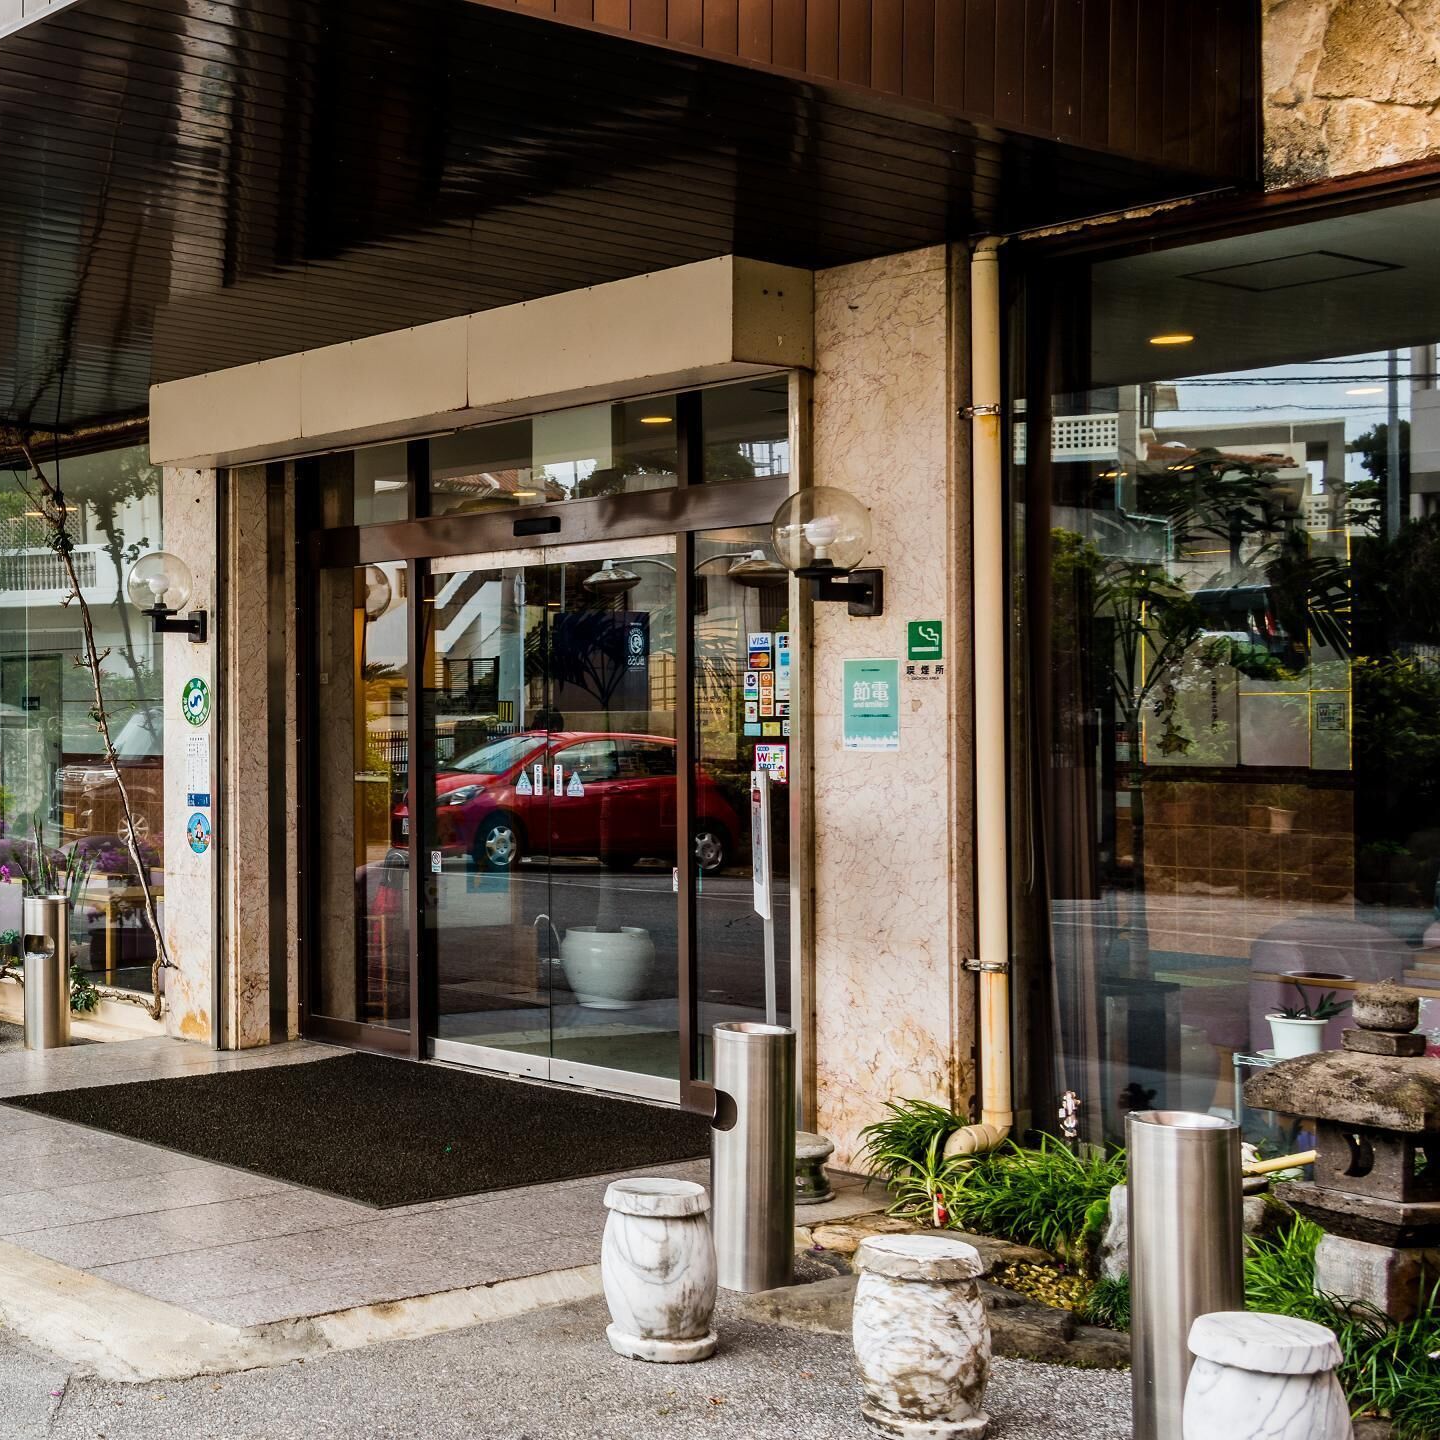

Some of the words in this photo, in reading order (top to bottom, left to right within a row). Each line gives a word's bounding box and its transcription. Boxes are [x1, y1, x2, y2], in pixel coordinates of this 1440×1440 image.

[751, 637, 769, 645] VISA
[906, 664, 944, 675] 喫煙所
[853, 681, 888, 701] 節電
